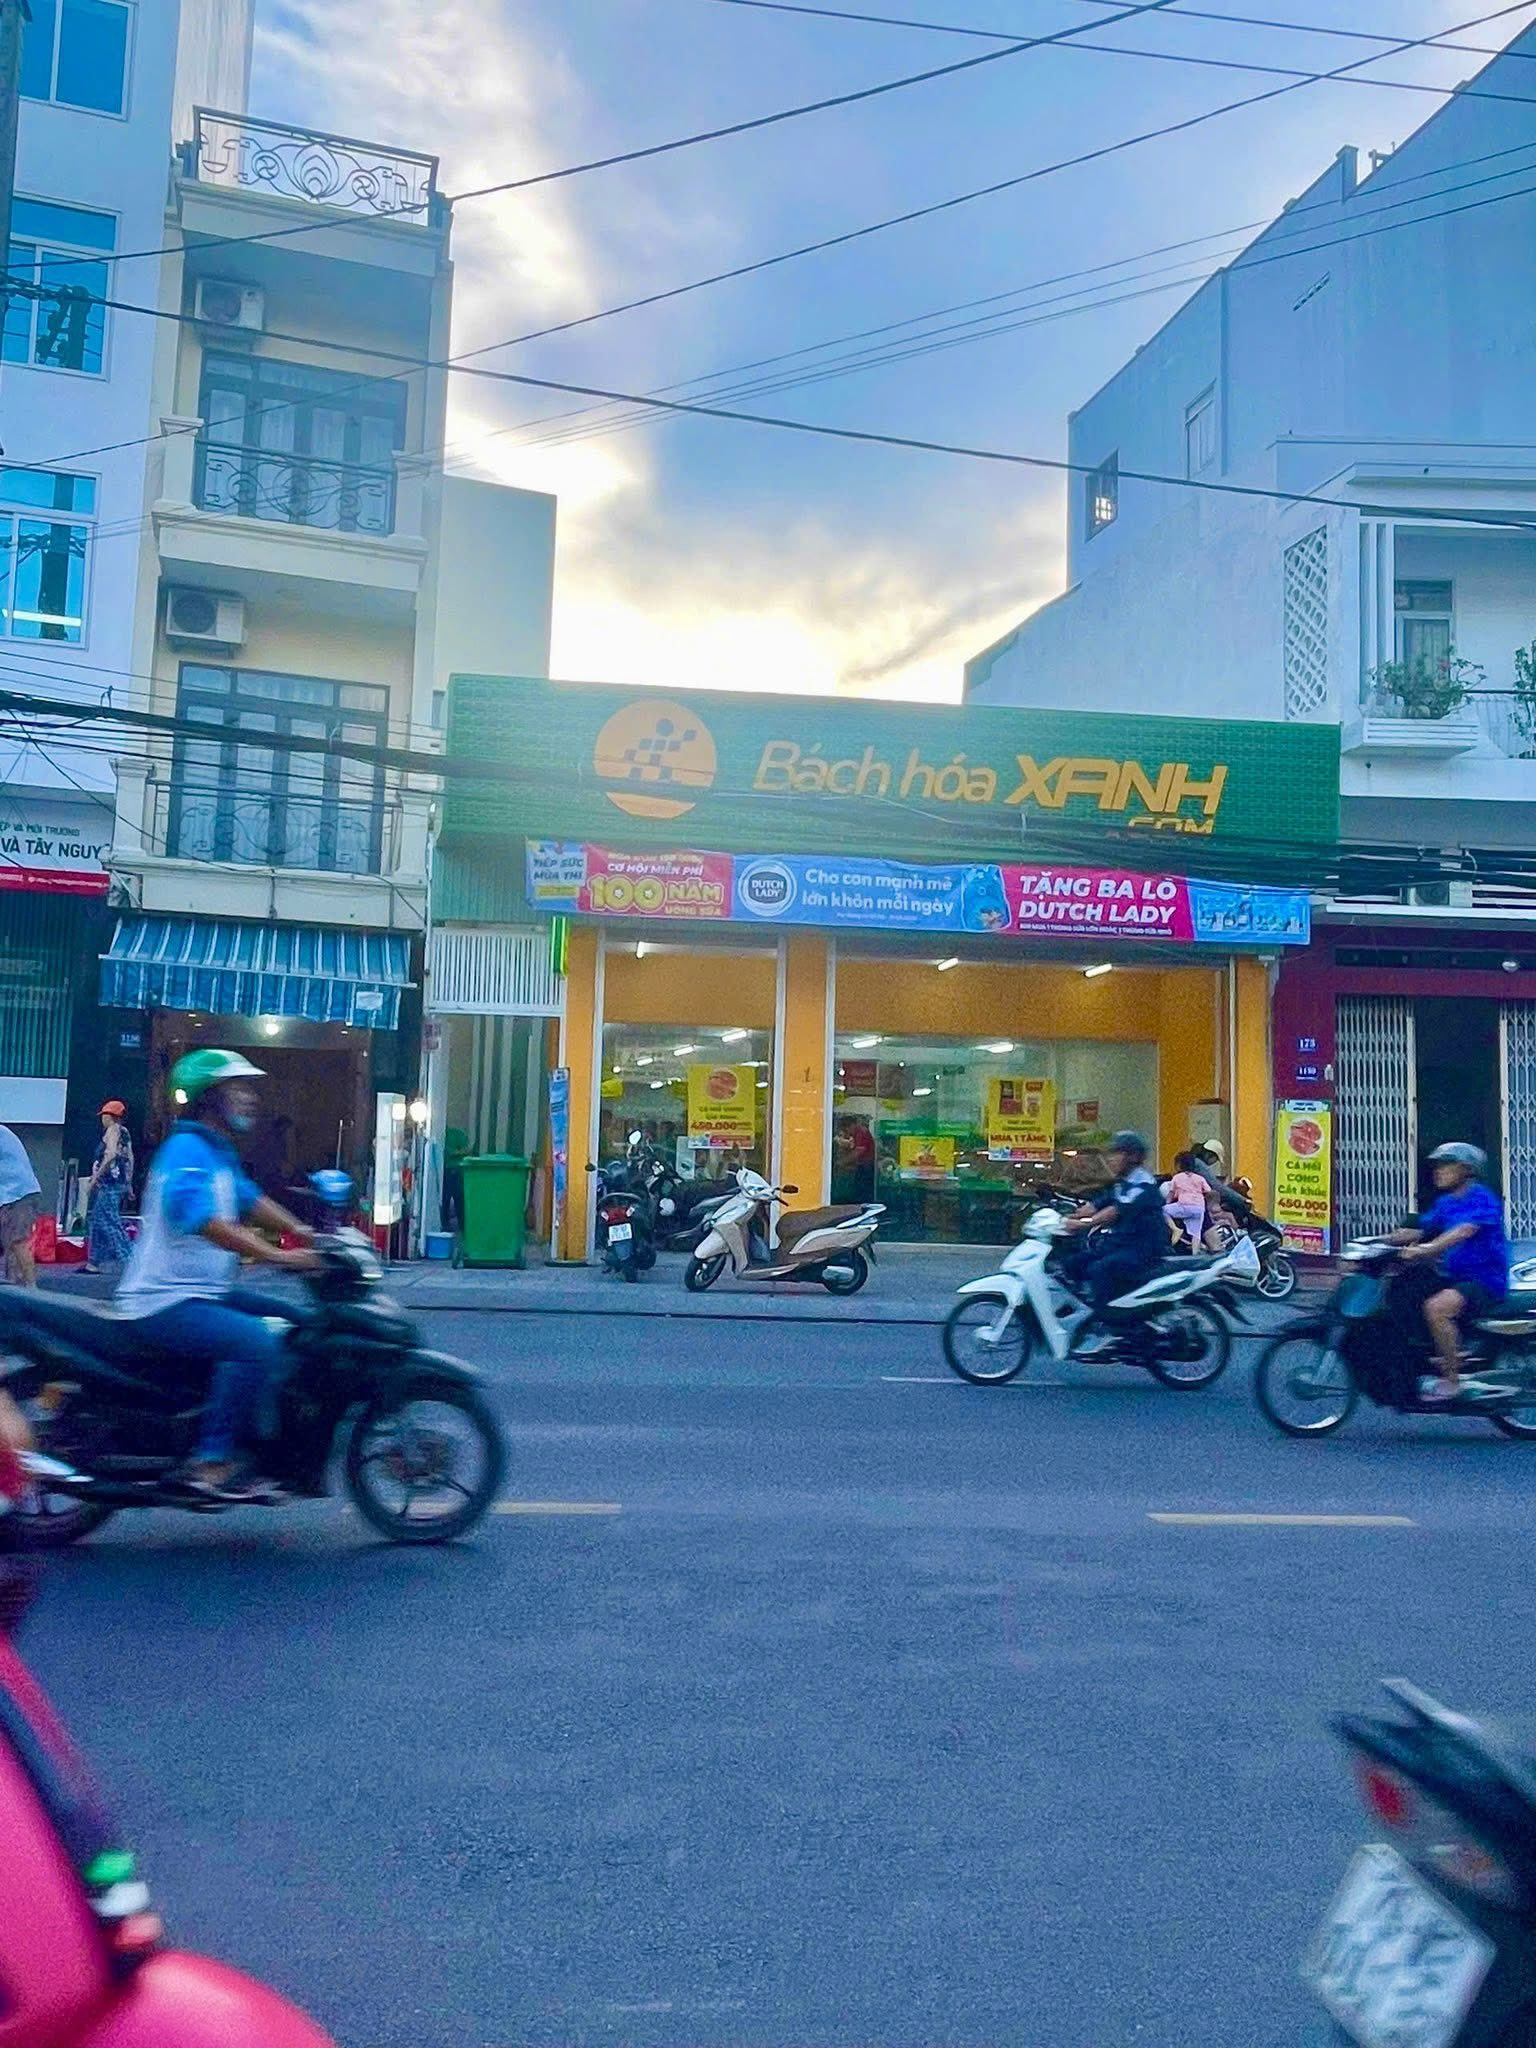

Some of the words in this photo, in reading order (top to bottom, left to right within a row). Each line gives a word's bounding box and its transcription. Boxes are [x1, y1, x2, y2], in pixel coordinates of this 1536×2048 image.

[753, 739, 892, 796] Bách
[901, 747, 997, 803] hóa
[1003, 755, 1229, 815] XANH
[1, 835, 20, 854] VÀ
[25, 837, 53, 856] TÂY
[751, 879, 784, 890] DUTCH
[805, 868, 839, 885] Cho
[842, 874, 873, 887] con
[874, 873, 923, 892] mạnh
[926, 876, 953, 891] mẽ
[1019, 871, 1092, 900] TẶNG
[1096, 879, 1135, 899] BA
[1141, 877, 1178, 901] LÔ
[588, 874, 666, 913] 100
[755, 888, 780, 898] LADY
[802, 890, 828, 906] lớn
[831, 890, 874, 910] khôn
[876, 890, 908, 910] mỗi
[909, 897, 955, 916] ngày
[1018, 900, 1104, 922] DUTCH
[1109, 904, 1177, 924] LADY
[1277, 1198, 1329, 1212] 450.000
